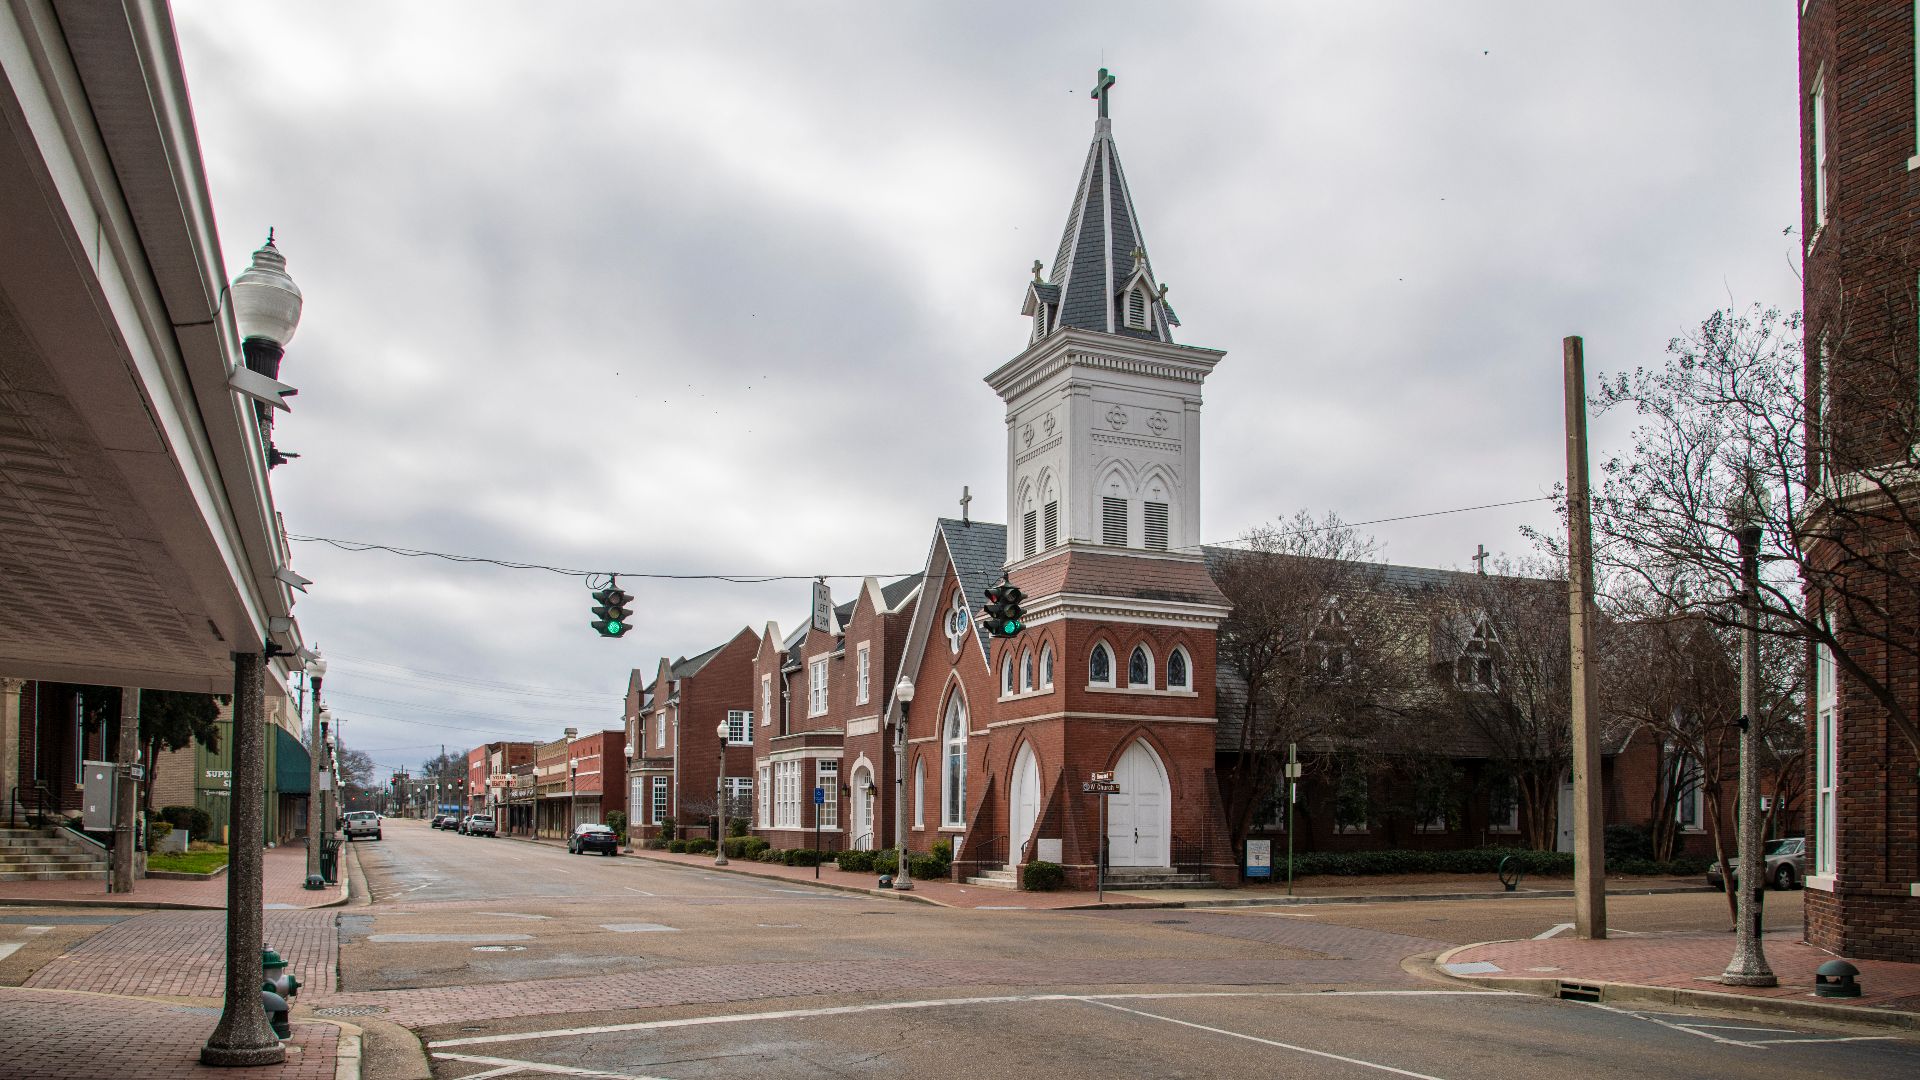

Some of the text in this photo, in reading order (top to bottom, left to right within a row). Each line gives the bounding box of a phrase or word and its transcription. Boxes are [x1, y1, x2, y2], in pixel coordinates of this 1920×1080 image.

[818, 588, 828, 601] NO
[817, 603, 829, 614] LEFT
[816, 614, 829, 627] TURN
[1096, 783, 1115, 791] Church
